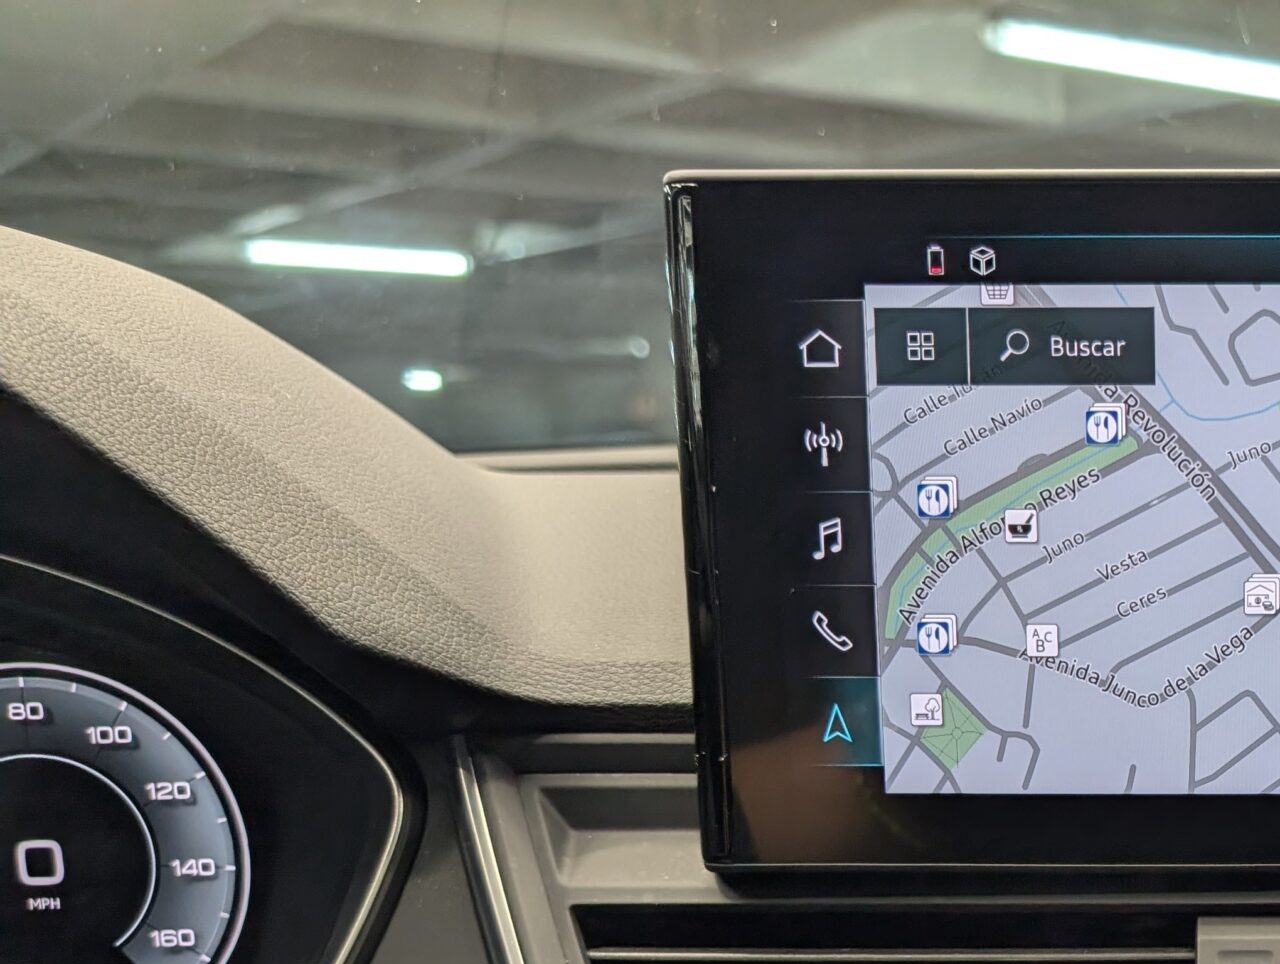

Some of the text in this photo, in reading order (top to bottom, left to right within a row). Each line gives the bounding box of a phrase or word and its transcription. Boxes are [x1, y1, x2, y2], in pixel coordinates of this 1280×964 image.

[1050, 336, 1126, 358] Buscar
[903, 394, 949, 424] Calle
[943, 398, 1043, 456] Calle Navío
[1123, 393, 1216, 502] Revolución
[1227, 440, 1272, 469] Juno
[898, 468, 1100, 625] Avenida Alfo Reyes
[1042, 533, 1085, 564] Juno
[1096, 550, 1148, 580] Vesta
[1117, 587, 1167, 618] Ceres
[1102, 674, 1160, 708] Junco
[1163, 677, 1188, 698] de
[1186, 663, 1209, 681] la
[1204, 627, 1254, 664] Vega
[8, 702, 45, 721] 80
[86, 726, 133, 744] 100
[145, 781, 192, 800] 120
[16, 839, 65, 886] 0
[170, 858, 216, 877] 140
[28, 897, 61, 910] MPH
[150, 929, 195, 947] 160
